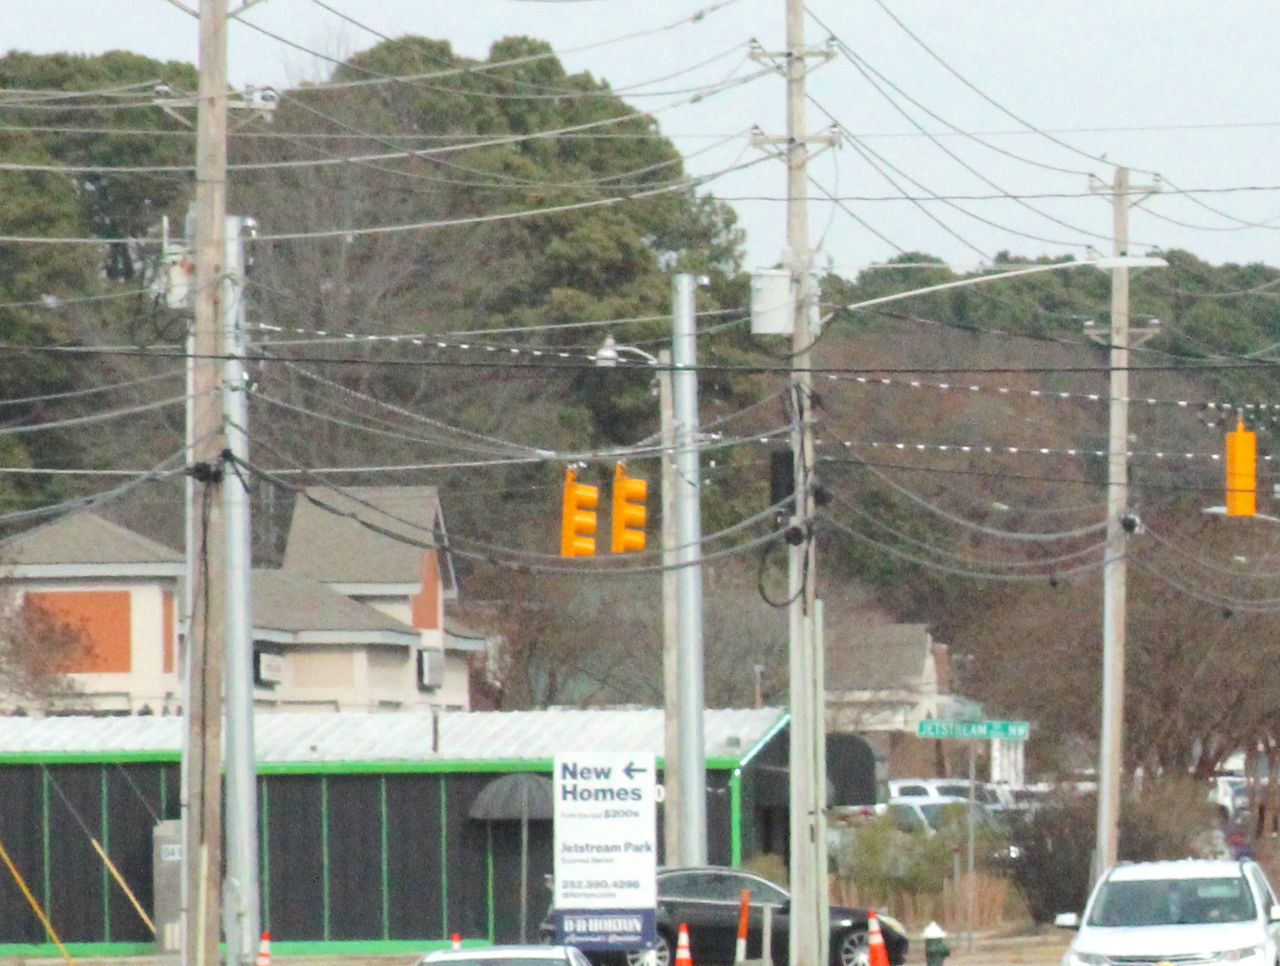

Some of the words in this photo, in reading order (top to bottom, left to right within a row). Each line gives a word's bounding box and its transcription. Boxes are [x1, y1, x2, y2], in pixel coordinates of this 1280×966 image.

[561, 762, 612, 780] New
[561, 783, 642, 801] Homes
[561, 843, 621, 853] Jetstream
[624, 841, 652, 853] Park
